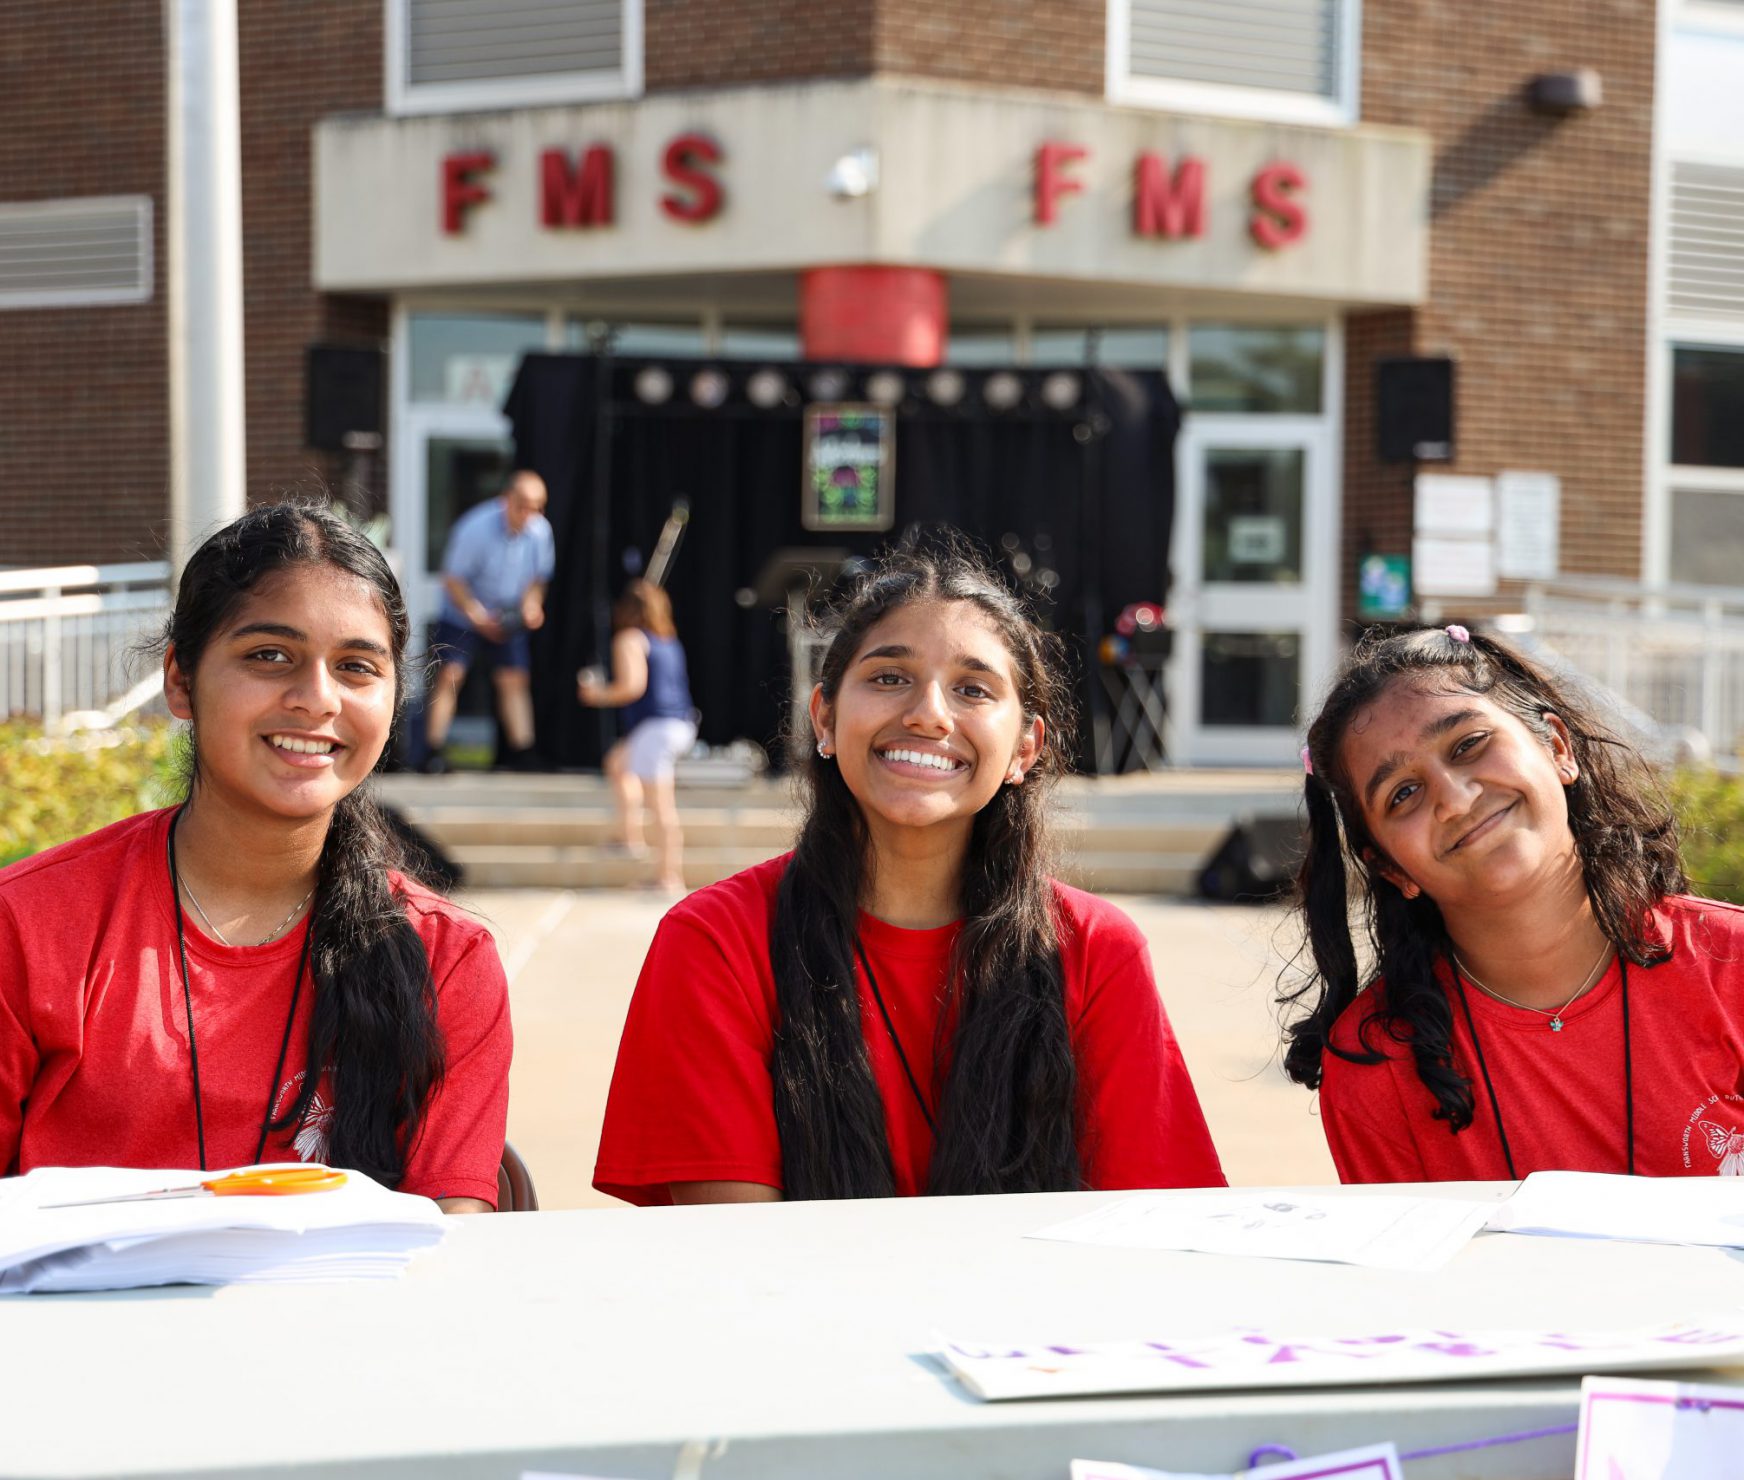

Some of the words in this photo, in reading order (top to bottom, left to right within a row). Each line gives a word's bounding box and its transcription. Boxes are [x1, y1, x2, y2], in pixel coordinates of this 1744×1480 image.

[441, 135, 728, 236] FMS
[1033, 141, 1312, 251] FMS
[1682, 1125, 1692, 1168] FARNSWORTH
[1689, 1103, 1708, 1123] MIDDLE
